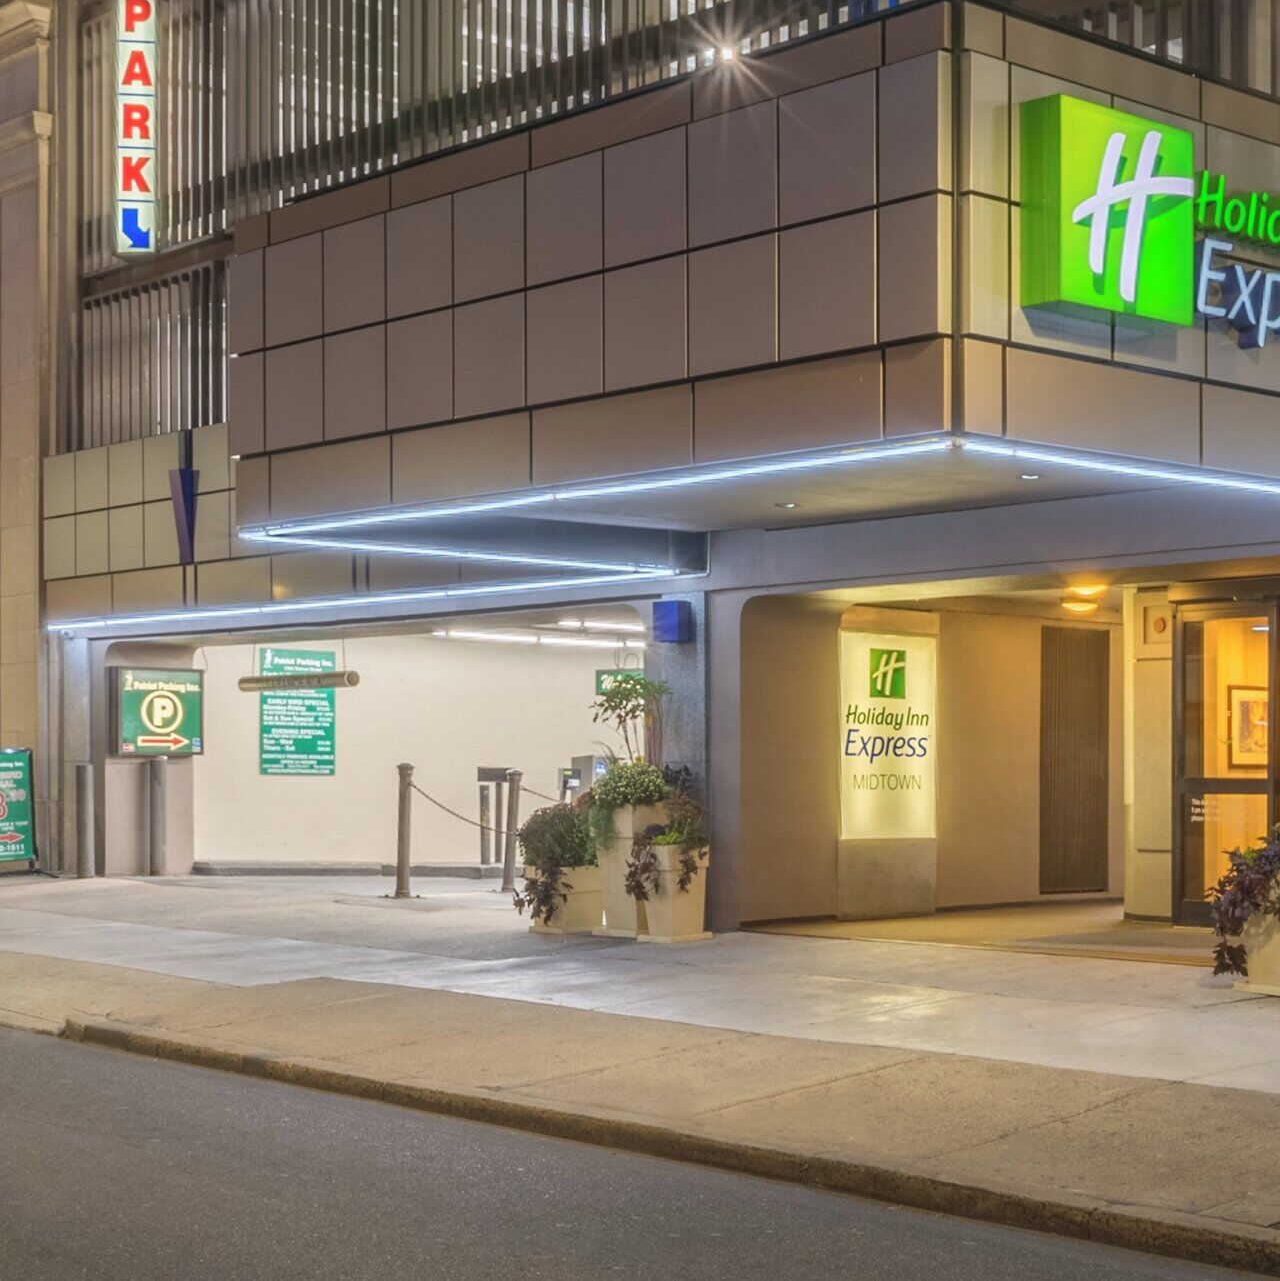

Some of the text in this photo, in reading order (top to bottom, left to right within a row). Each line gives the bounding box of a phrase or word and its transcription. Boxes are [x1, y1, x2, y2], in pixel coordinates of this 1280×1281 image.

[273, 656, 295, 665] Patriot
[296, 657, 321, 668] Parking
[133, 681, 157, 690] Patriot
[158, 682, 186, 693] Parking
[304, 699, 330, 707] SPECIAL
[153, 697, 175, 726] P
[845, 704, 929, 731] Holiday Inn
[300, 728, 326, 736] SPECIAL
[844, 728, 929, 765] Express
[0, 770, 23, 780] BIRD
[852, 774, 923, 792] MIDTOWN
